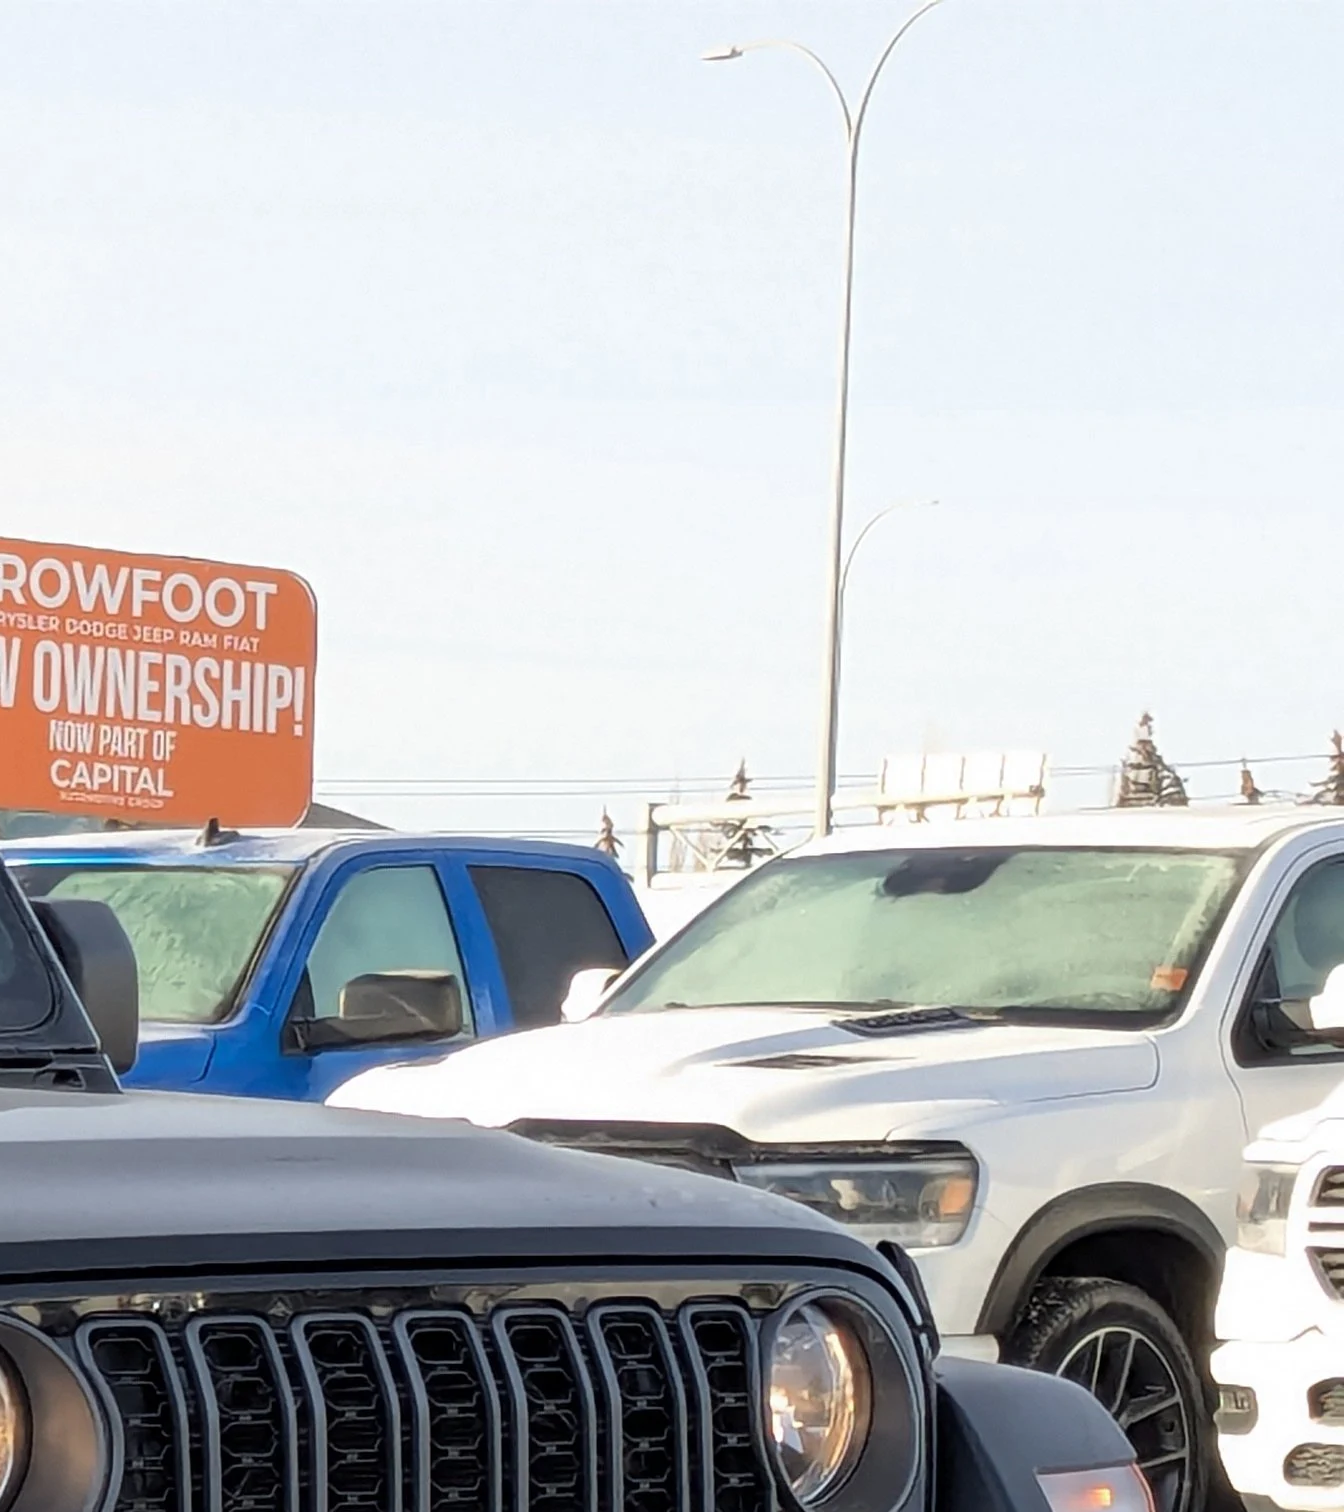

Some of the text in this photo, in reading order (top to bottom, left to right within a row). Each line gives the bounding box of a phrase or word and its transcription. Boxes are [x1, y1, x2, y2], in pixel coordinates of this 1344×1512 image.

[64, 617, 129, 641] DODGE
[132, 624, 175, 645] JEEP
[179, 630, 218, 650] RAM
[223, 634, 261, 653] FIAT
[33, 640, 307, 737] OWNERSHIP!
[49, 719, 178, 762] NOW PART OF
[50, 758, 175, 798] CAPITAL
